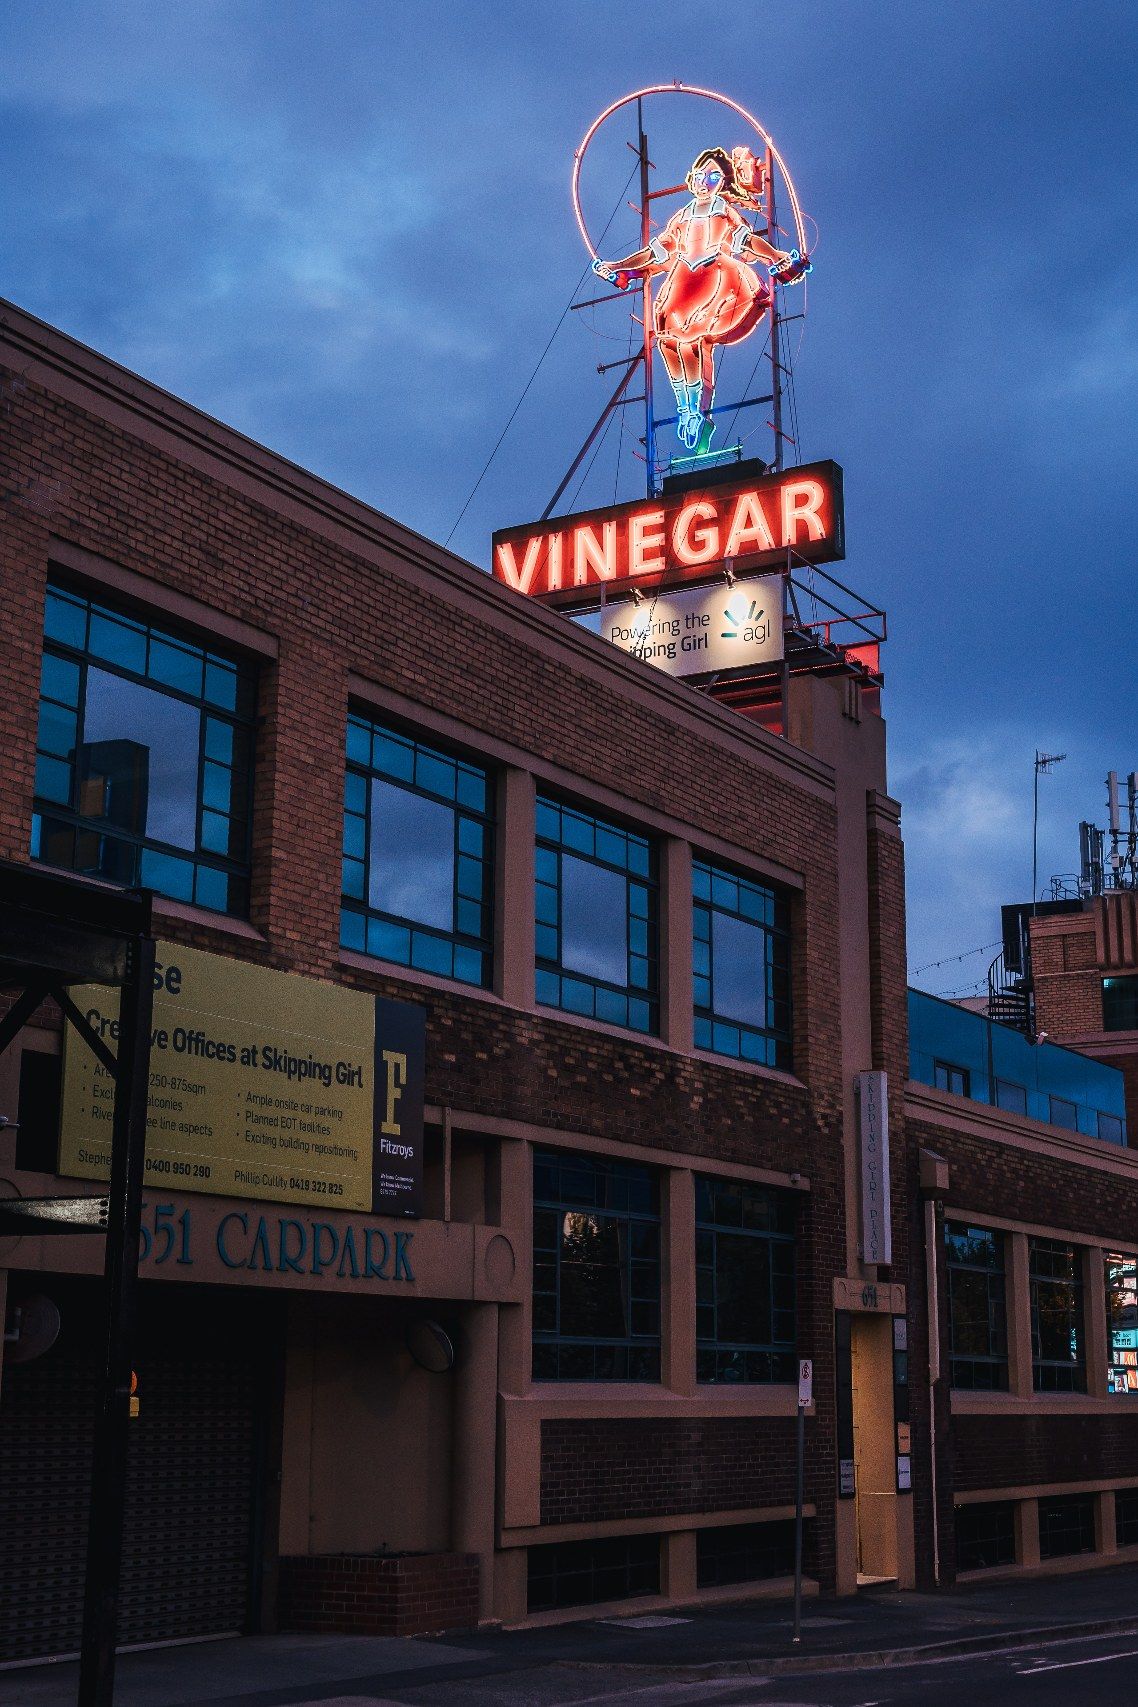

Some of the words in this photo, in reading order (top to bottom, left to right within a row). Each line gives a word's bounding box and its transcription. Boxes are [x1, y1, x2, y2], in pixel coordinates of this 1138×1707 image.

[497, 480, 825, 595] VINEGAR
[685, 612, 710, 630] the
[743, 619, 771, 645] agl
[681, 632, 708, 652] Girl
[172, 1027, 237, 1063] Offices
[240, 1044, 258, 1068] at
[261, 1045, 333, 1088] Skipping
[335, 1061, 364, 1089] Girl
[149, 1073, 206, 1096] 250-875sqm
[246, 1091, 273, 1107] Ample
[274, 1097, 299, 1112] onsite
[300, 1103, 313, 1114] car
[314, 1105, 343, 1121] parking
[160, 1116, 176, 1131] line
[179, 1121, 213, 1137] aspects
[245, 1110, 279, 1127] Planned
[299, 1119, 331, 1135] facilities
[245, 1130, 277, 1149] Exciting
[279, 1135, 310, 1154] building
[311, 1143, 358, 1161] repositioning
[380, 1138, 414, 1160] Fitzroys
[145, 1158, 171, 1174] 0400
[172, 1162, 191, 1176] 950
[234, 1170, 261, 1186] Phillip
[312, 1180, 327, 1194] 322
[216, 1211, 416, 1282] CARPARK
